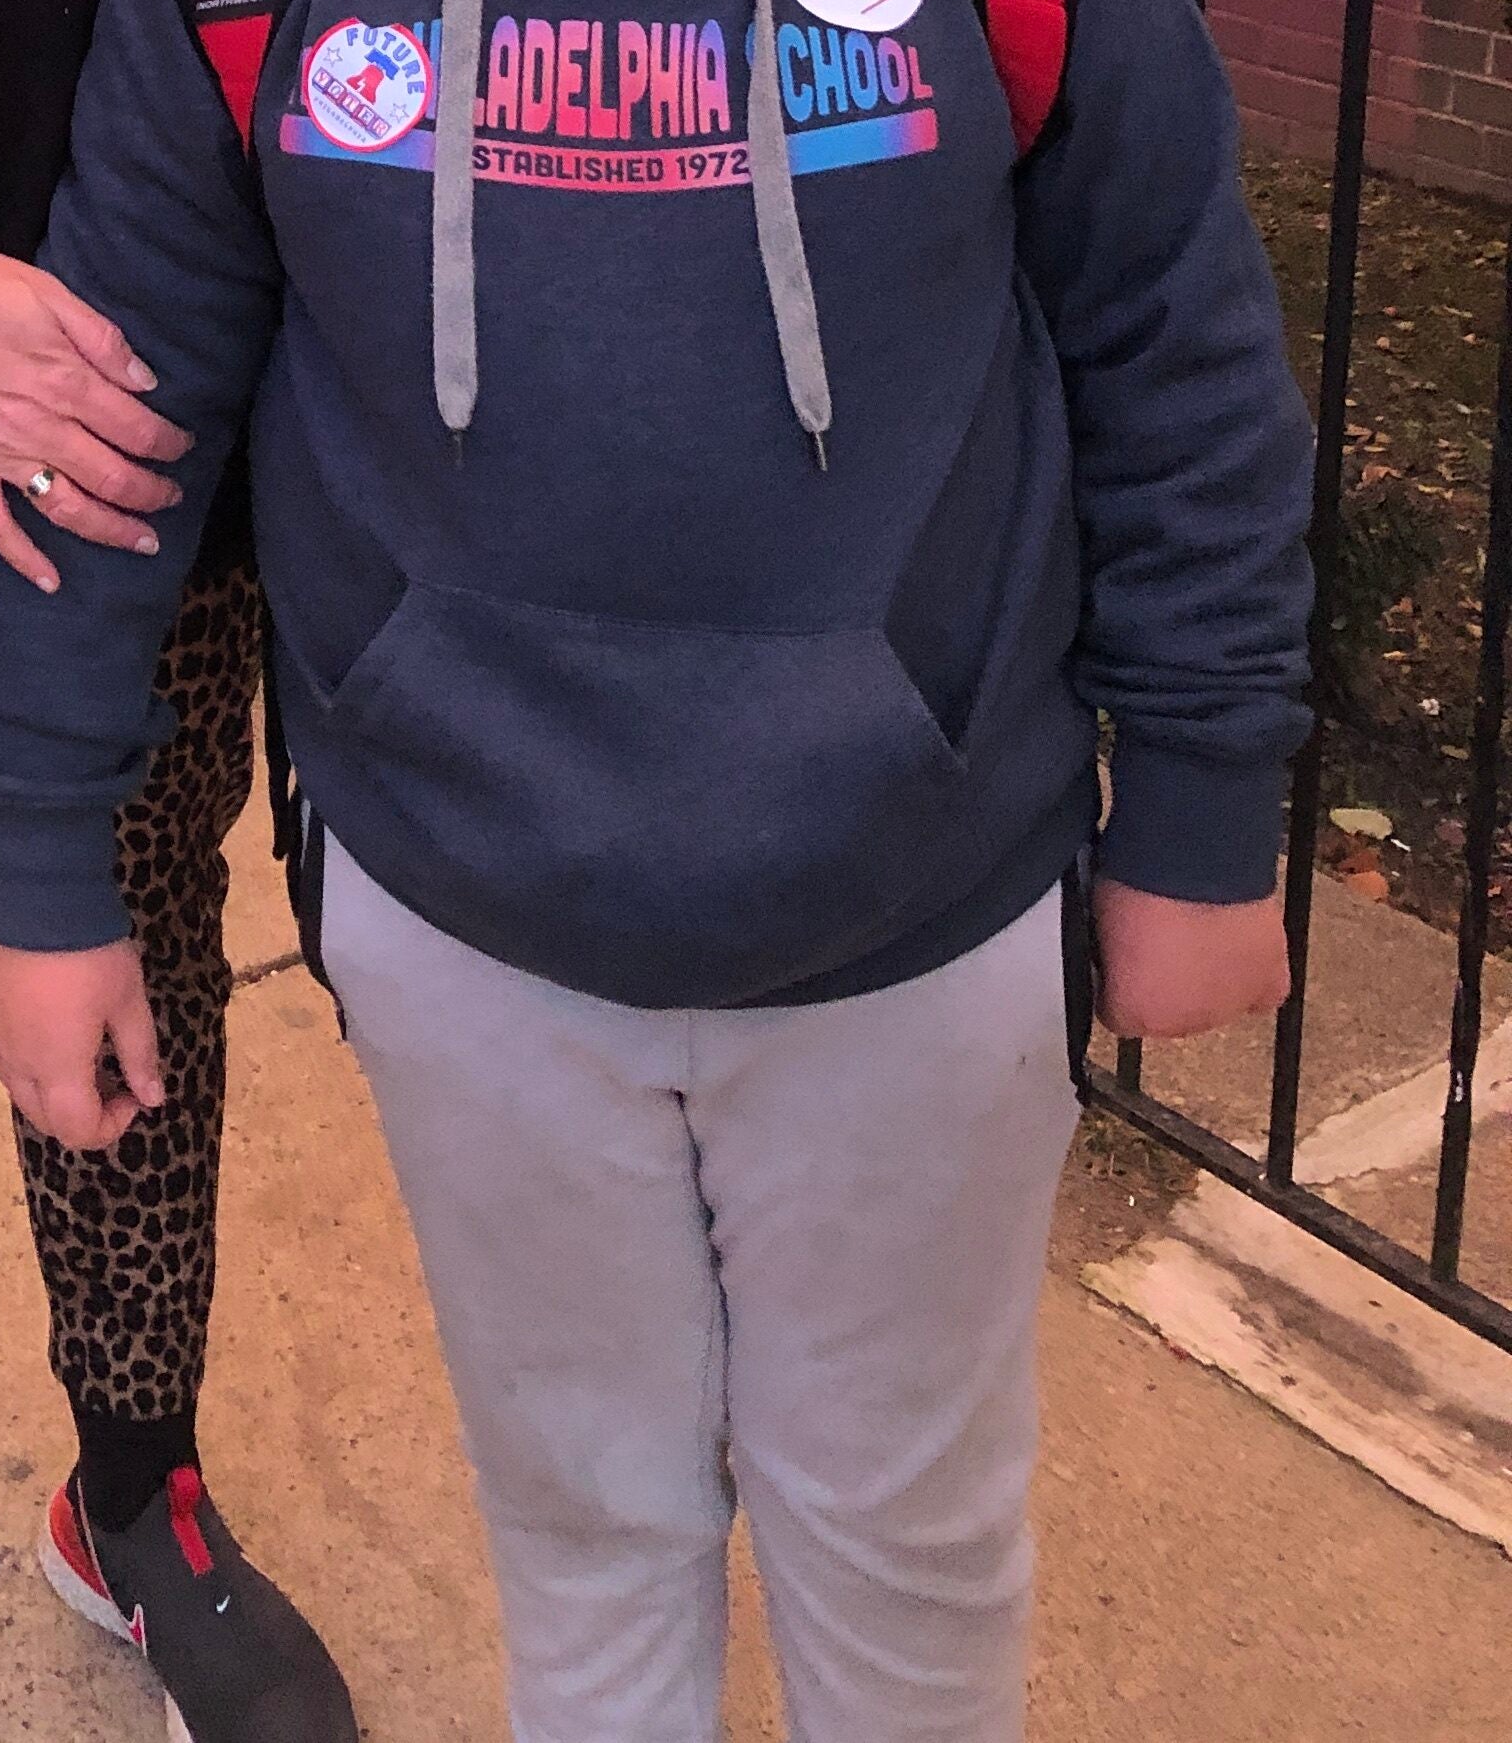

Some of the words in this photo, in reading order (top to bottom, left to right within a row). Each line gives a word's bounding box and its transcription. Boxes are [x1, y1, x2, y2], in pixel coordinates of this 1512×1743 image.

[345, 27, 425, 95] FUTURE
[414, 15, 731, 141] ADELPHIA
[745, 23, 933, 122] CHOOL
[314, 69, 390, 138] VOTER
[472, 146, 664, 183] STABLISHED
[676, 149, 750, 181] 1972
